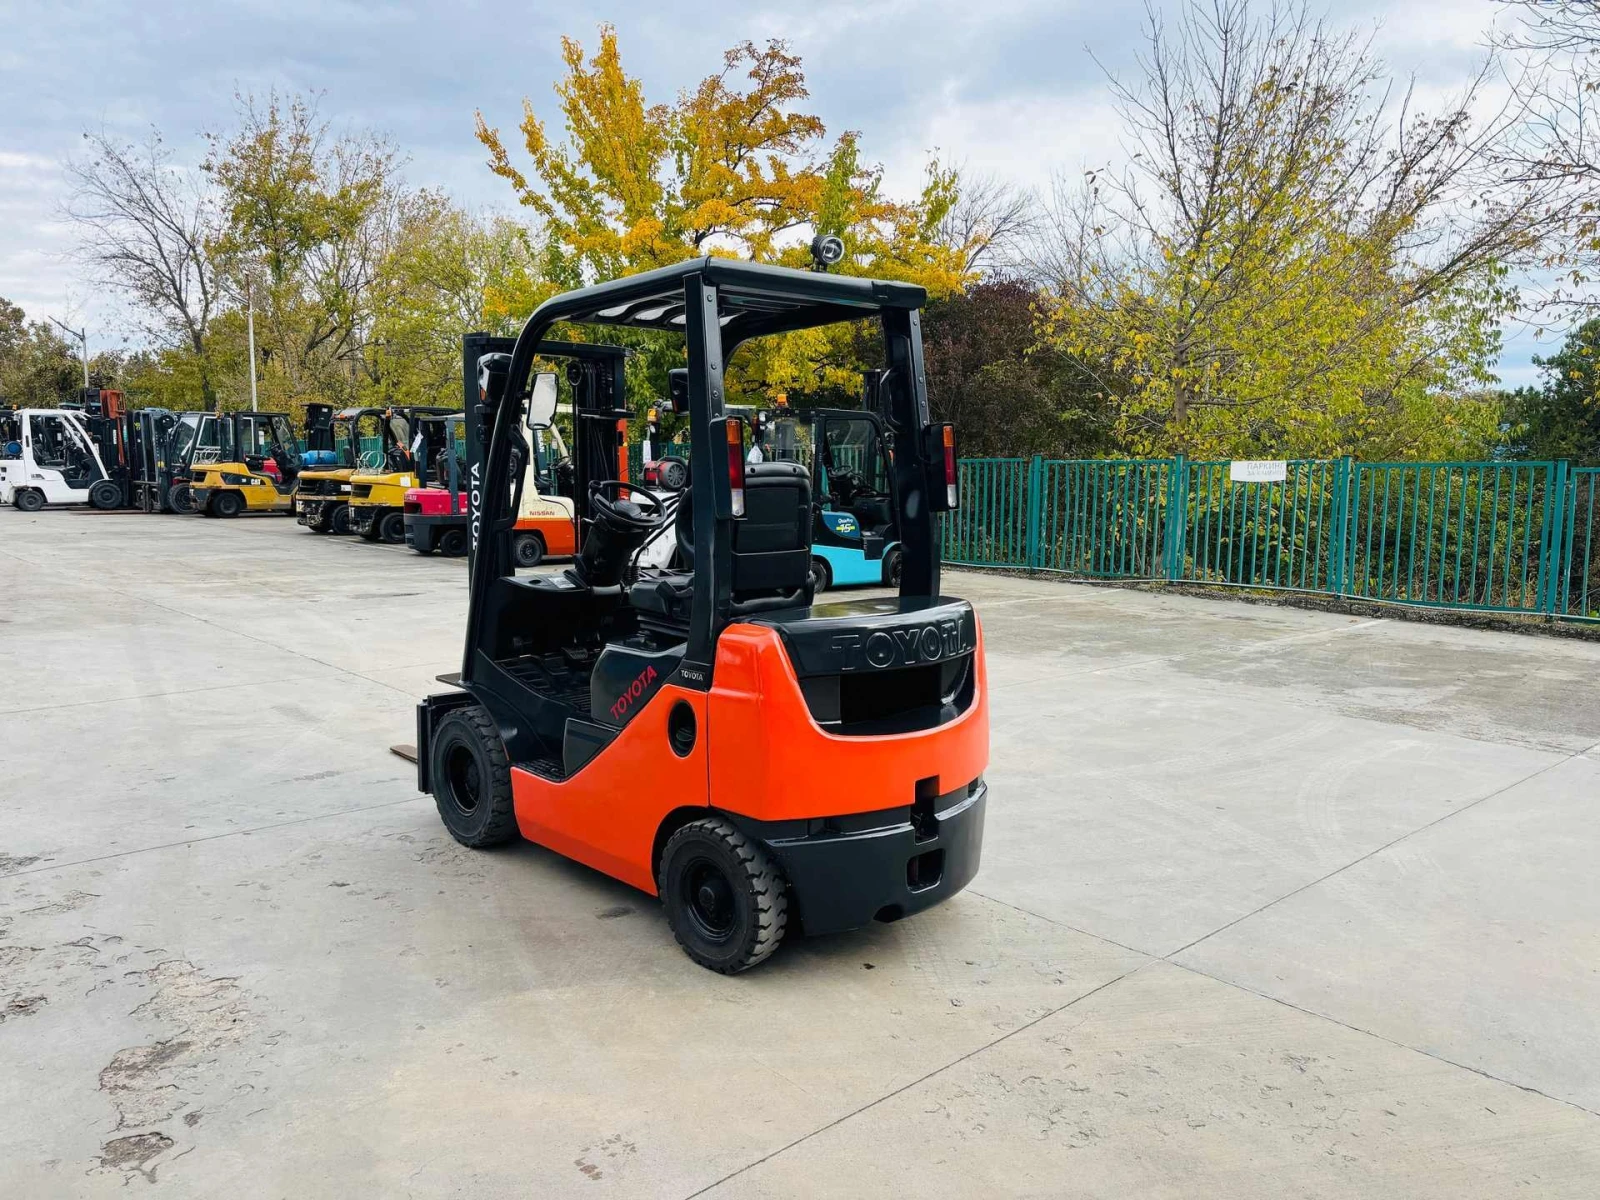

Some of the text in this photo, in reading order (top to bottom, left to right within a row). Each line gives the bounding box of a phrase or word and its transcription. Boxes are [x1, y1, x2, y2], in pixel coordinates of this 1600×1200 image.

[471, 462, 480, 550] TOYOTA
[610, 665, 657, 719] TOYOTA
[681, 670, 703, 680] TOYOTA
